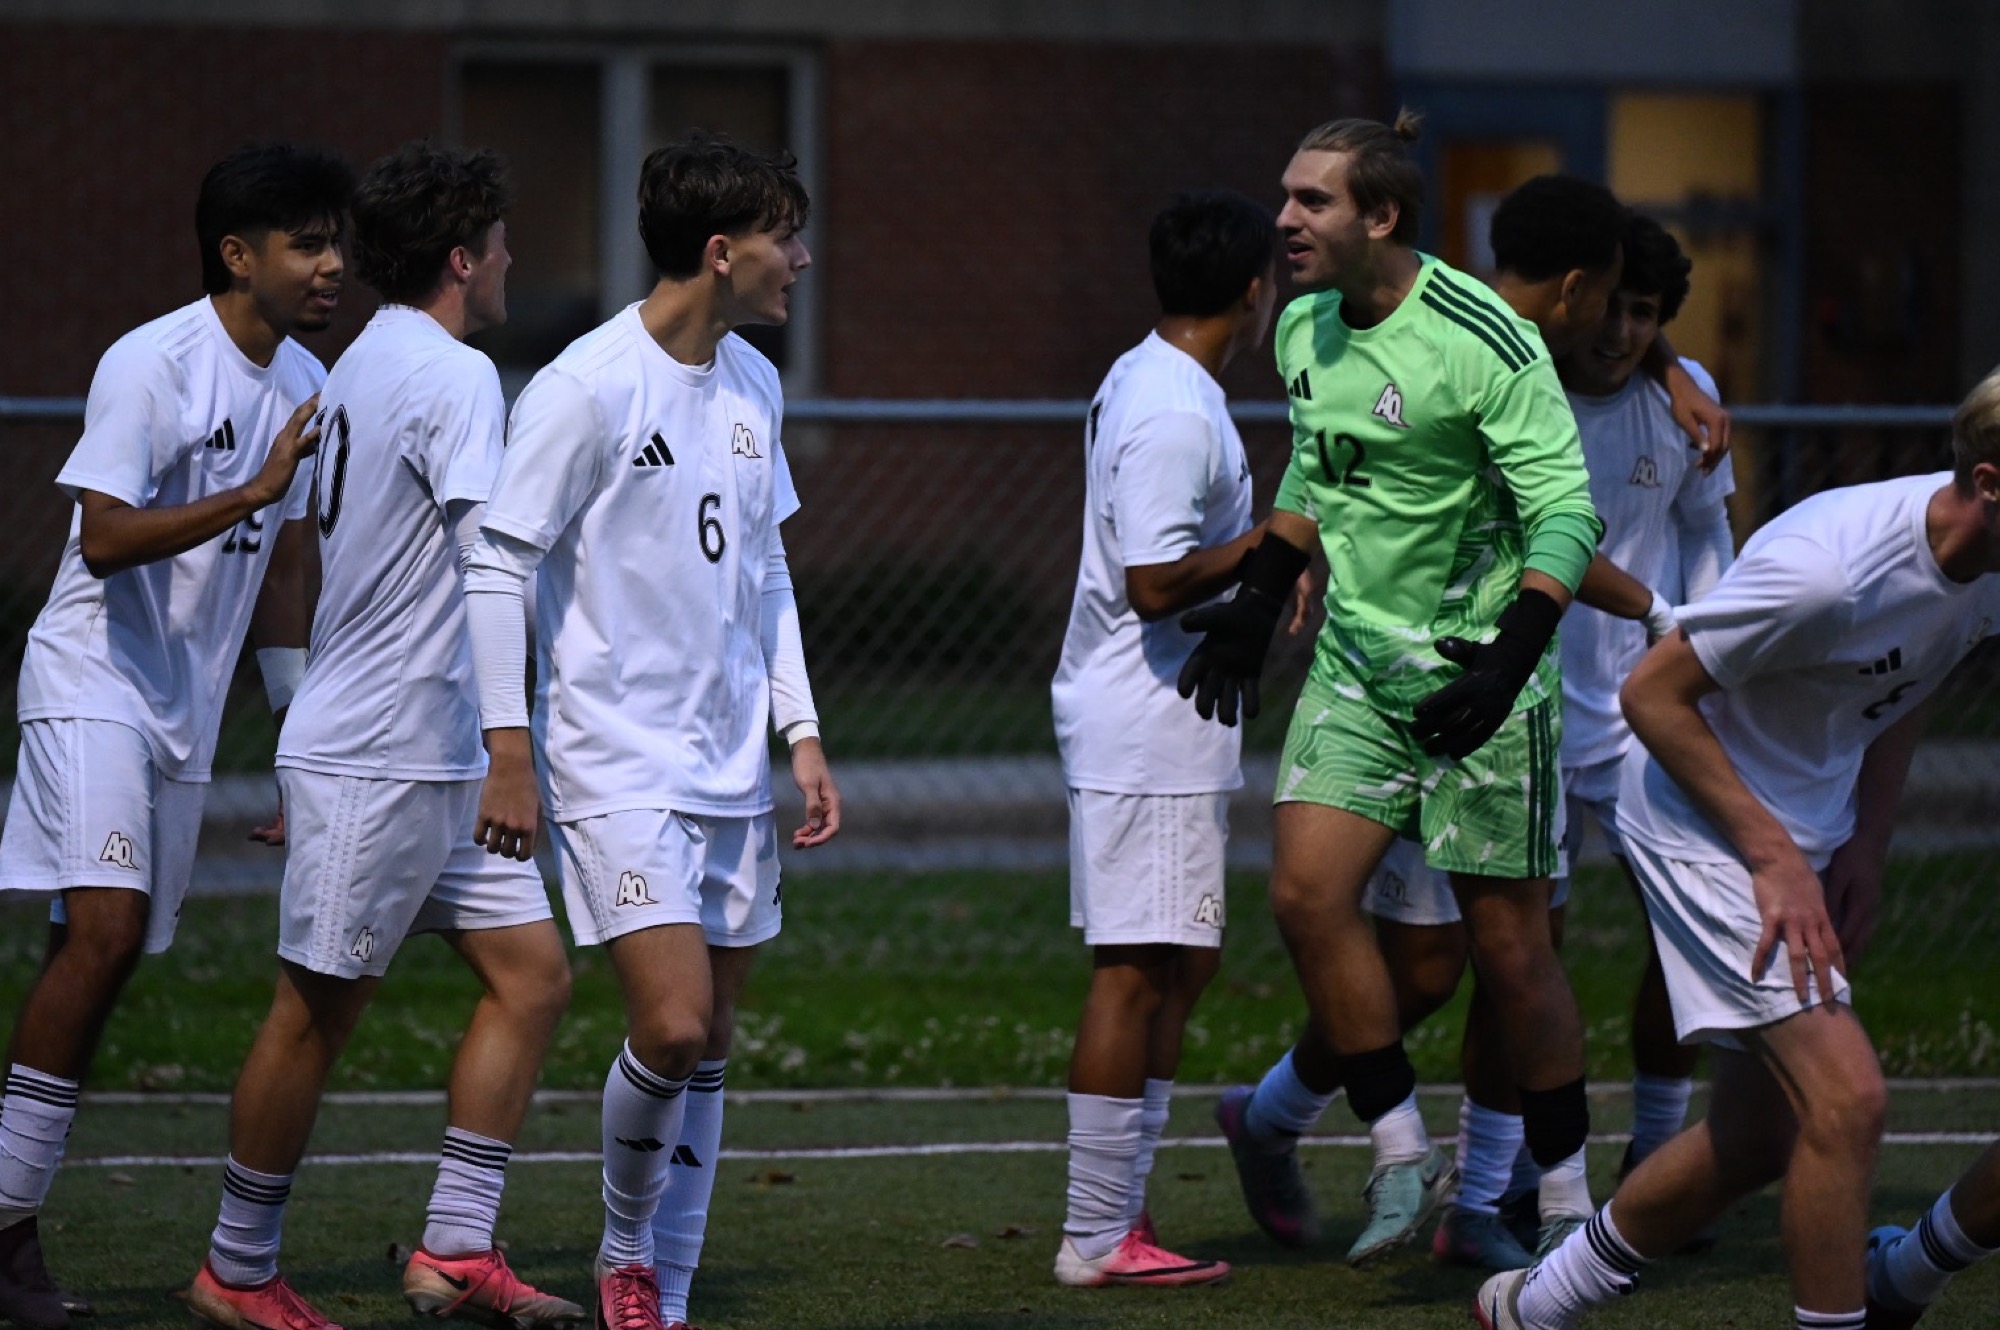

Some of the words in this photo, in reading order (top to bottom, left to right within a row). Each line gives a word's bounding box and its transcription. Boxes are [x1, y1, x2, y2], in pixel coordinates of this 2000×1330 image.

[1371, 383, 1412, 428] AQ
[732, 423, 763, 458] AQ
[1315, 427, 1373, 488] 12
[1629, 454, 1663, 488] AQ
[698, 491, 727, 564] 6
[99, 831, 140, 871] AQ
[615, 870, 660, 907] AQ
